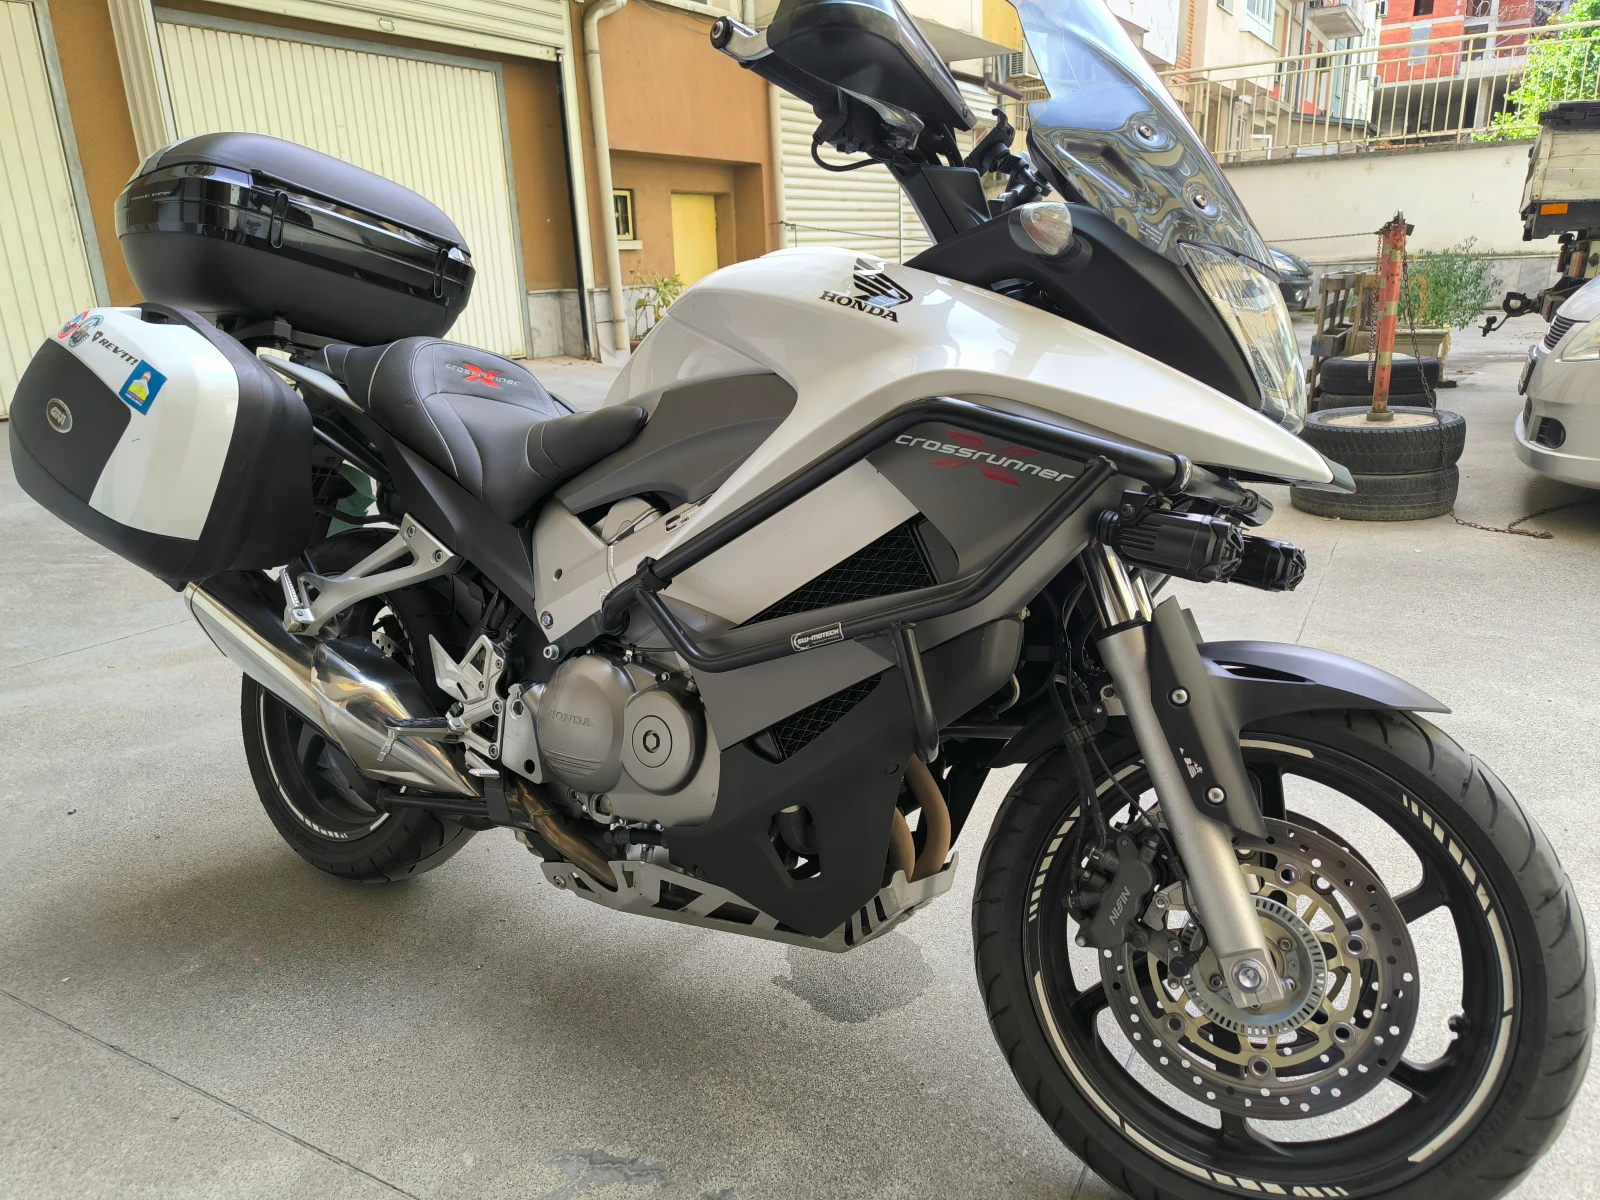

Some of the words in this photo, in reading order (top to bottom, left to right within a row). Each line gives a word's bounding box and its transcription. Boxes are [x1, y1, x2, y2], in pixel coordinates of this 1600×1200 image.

[819, 290, 899, 323] HONDA
[445, 362, 522, 386] crossrunner
[894, 434, 1077, 483] crossrunner
[797, 628, 840, 645] SW-MOTECH
[547, 709, 594, 728] HONDA
